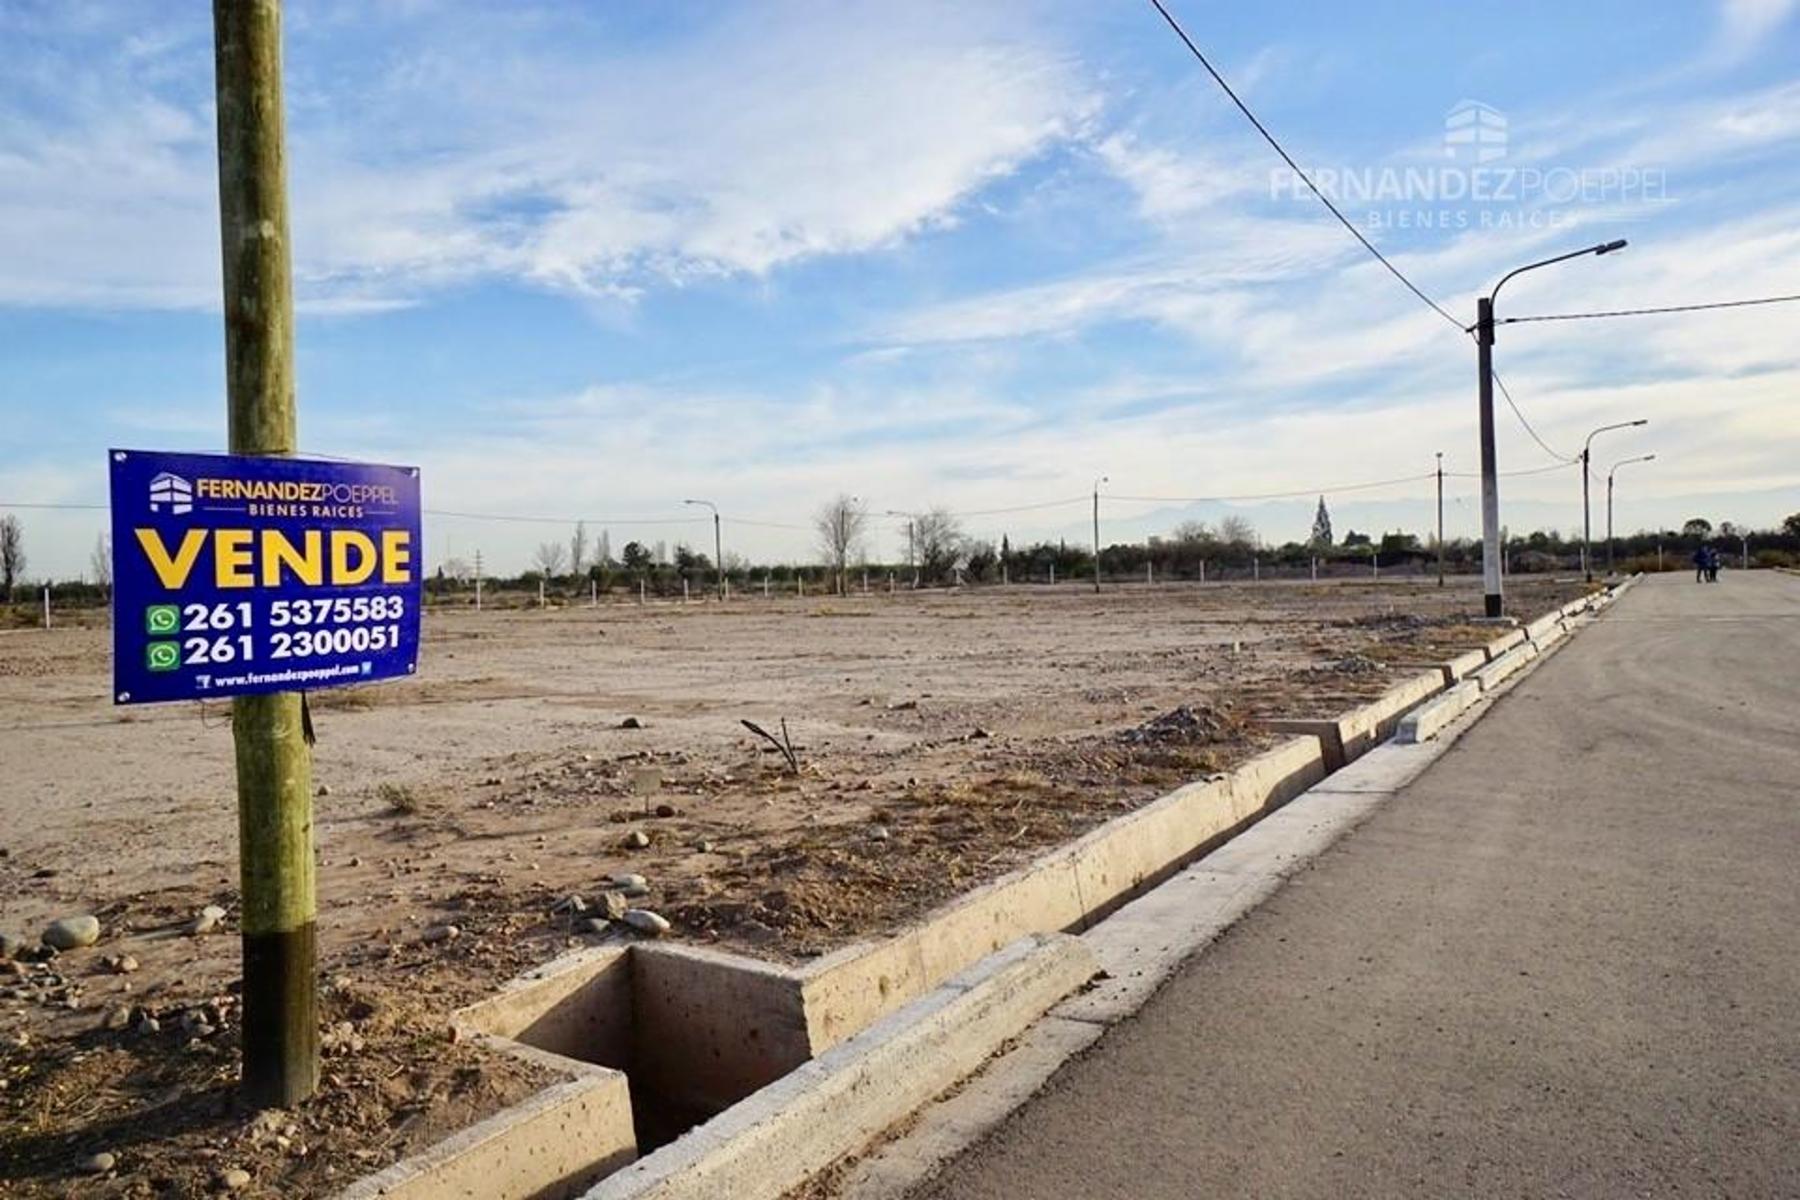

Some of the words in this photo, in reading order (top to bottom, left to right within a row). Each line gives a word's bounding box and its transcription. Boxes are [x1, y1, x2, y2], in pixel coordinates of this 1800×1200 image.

[249, 503, 308, 517] BIENES
[312, 505, 364, 519] RAICES
[134, 528, 411, 590] VENDE
[183, 602, 253, 631] 261
[269, 596, 405, 627] 5375583
[184, 634, 254, 665] 261
[270, 626, 400, 659] 2300051
[215, 664, 360, 687] www.fernandezpoeppel.com
